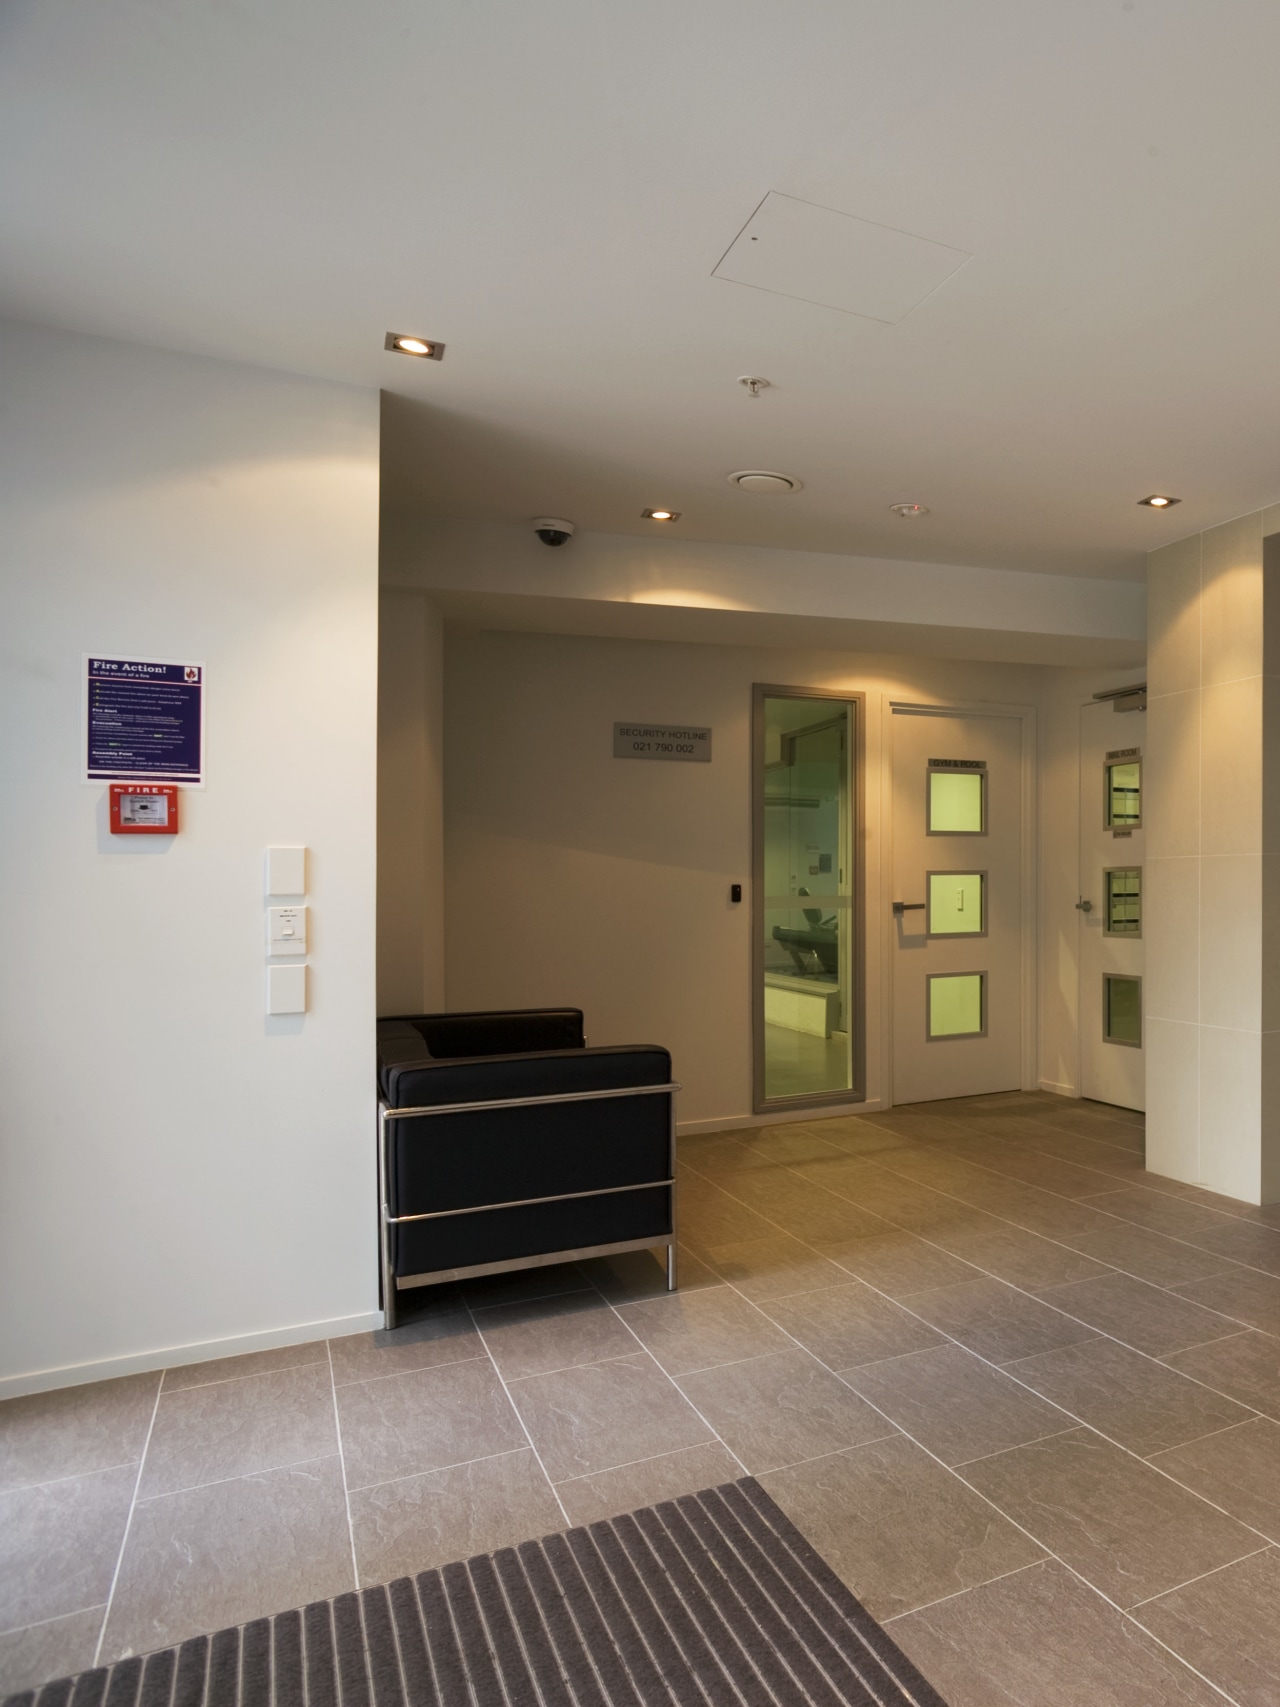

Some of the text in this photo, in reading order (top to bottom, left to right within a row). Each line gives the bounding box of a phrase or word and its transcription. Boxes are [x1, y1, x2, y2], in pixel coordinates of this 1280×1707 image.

[93, 661, 167, 674] Fire Action!
[619, 728, 708, 740] SECURITY HOTLINE
[632, 741, 694, 753] 021 790 002
[1109, 748, 1137, 760] MAIL ROOM
[933, 759, 952, 767] GYM
[960, 760, 981, 769] POOL
